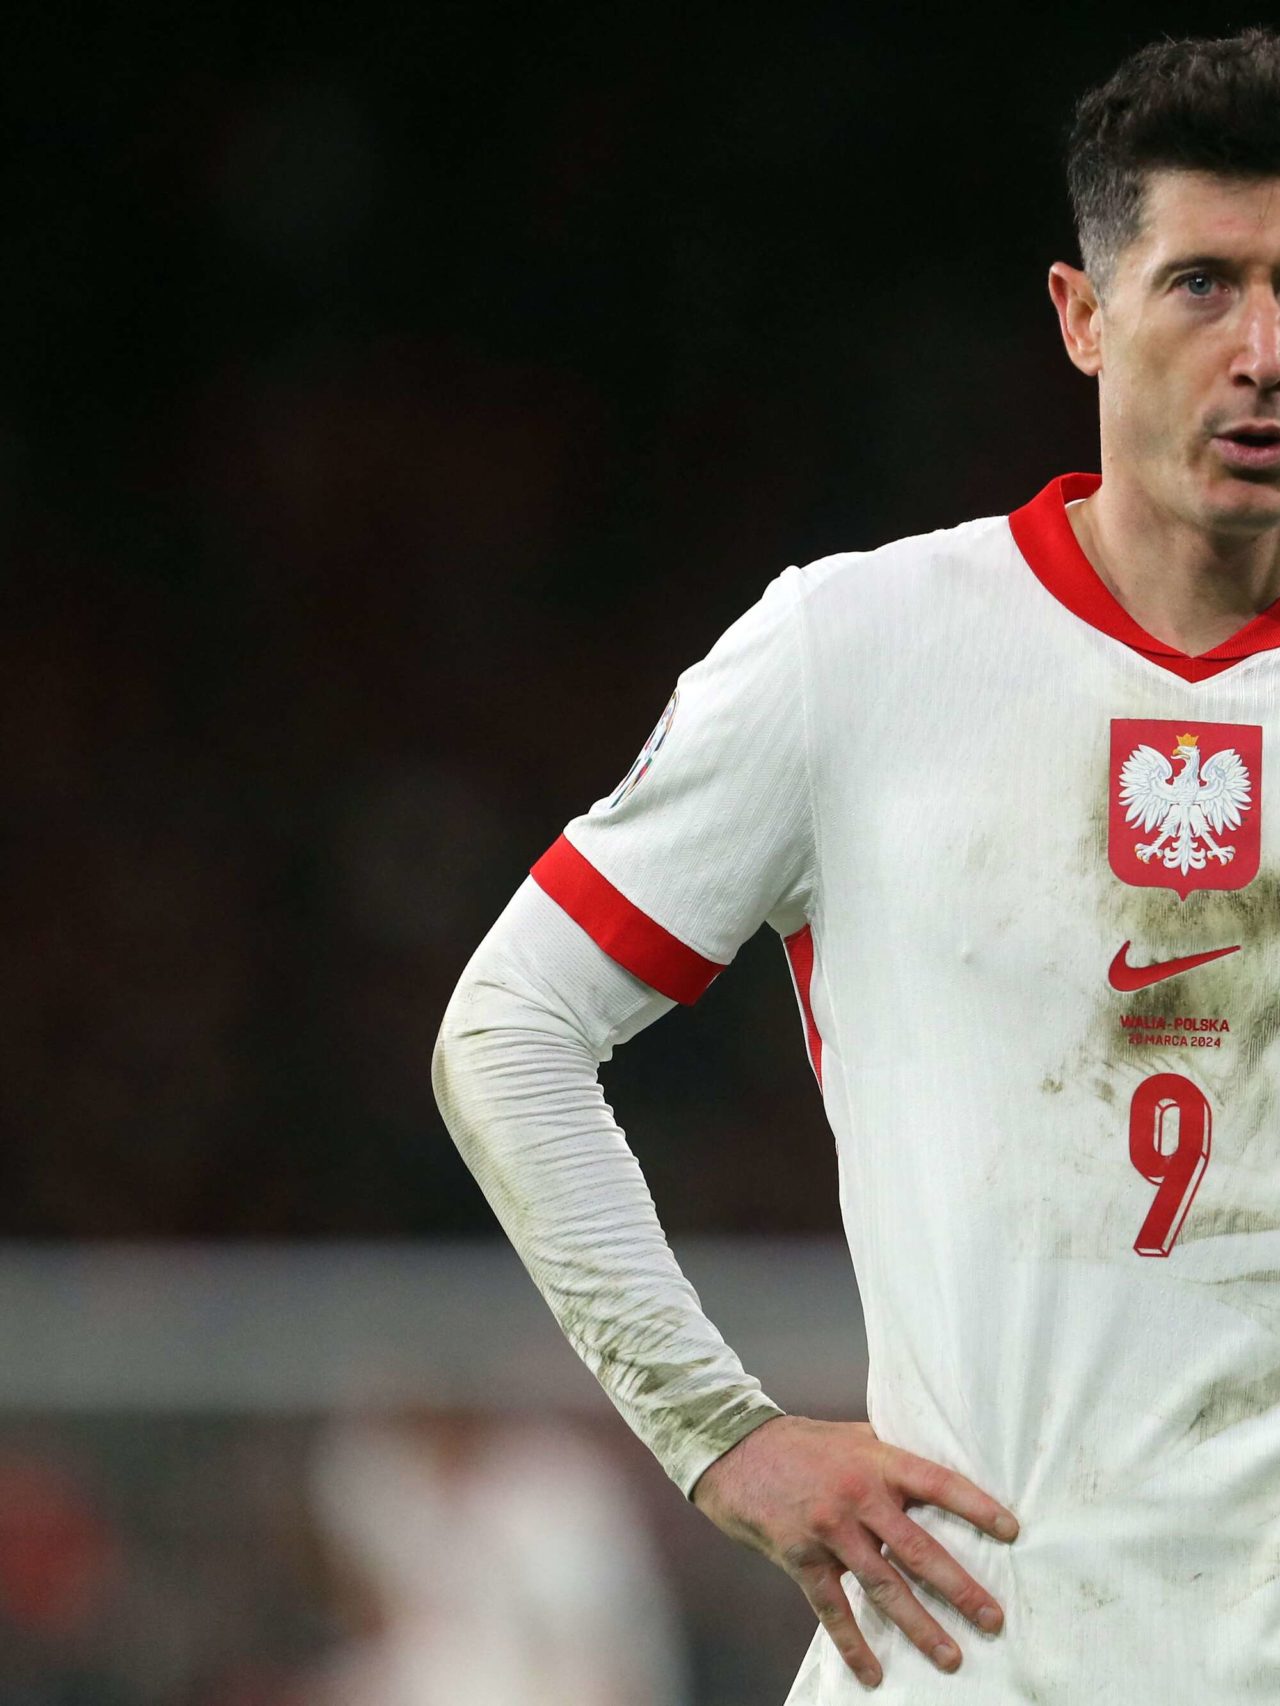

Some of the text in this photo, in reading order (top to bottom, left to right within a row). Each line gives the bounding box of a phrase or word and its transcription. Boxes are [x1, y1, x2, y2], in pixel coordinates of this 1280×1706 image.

[1144, 1034, 1188, 1047] MARCA
[1191, 1036, 1221, 1048] 2024
[1129, 1073, 1212, 1257] 9
